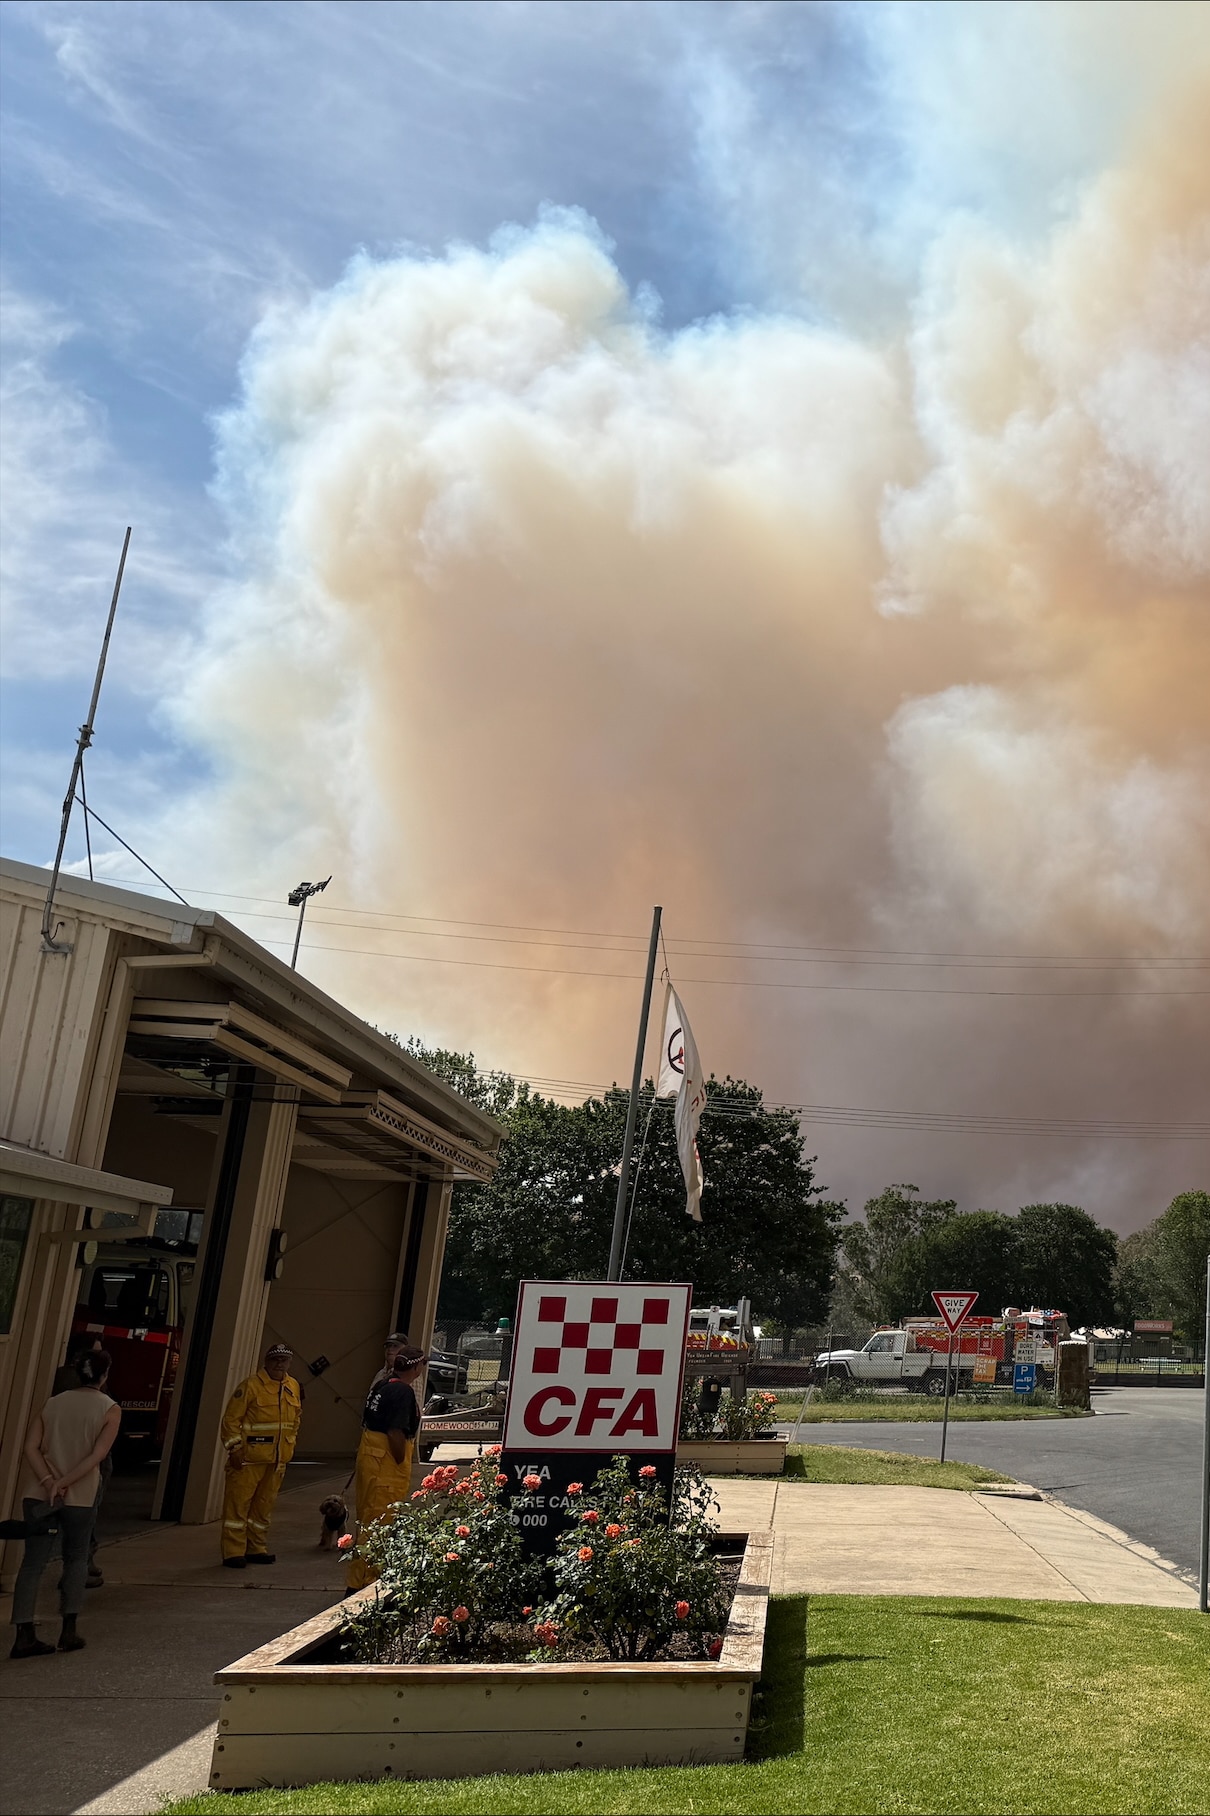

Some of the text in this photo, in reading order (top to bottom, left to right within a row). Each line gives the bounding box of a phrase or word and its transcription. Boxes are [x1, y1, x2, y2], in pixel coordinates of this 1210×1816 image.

[945, 1299, 965, 1307] GIVE
[1021, 1366, 1029, 1375] P
[120, 1400, 156, 1408] RESCUE
[523, 1385, 659, 1437] CFA
[423, 1421, 474, 1431] HOMEWOOD
[513, 1464, 551, 1480] YEA
[522, 1514, 548, 1527] 000
